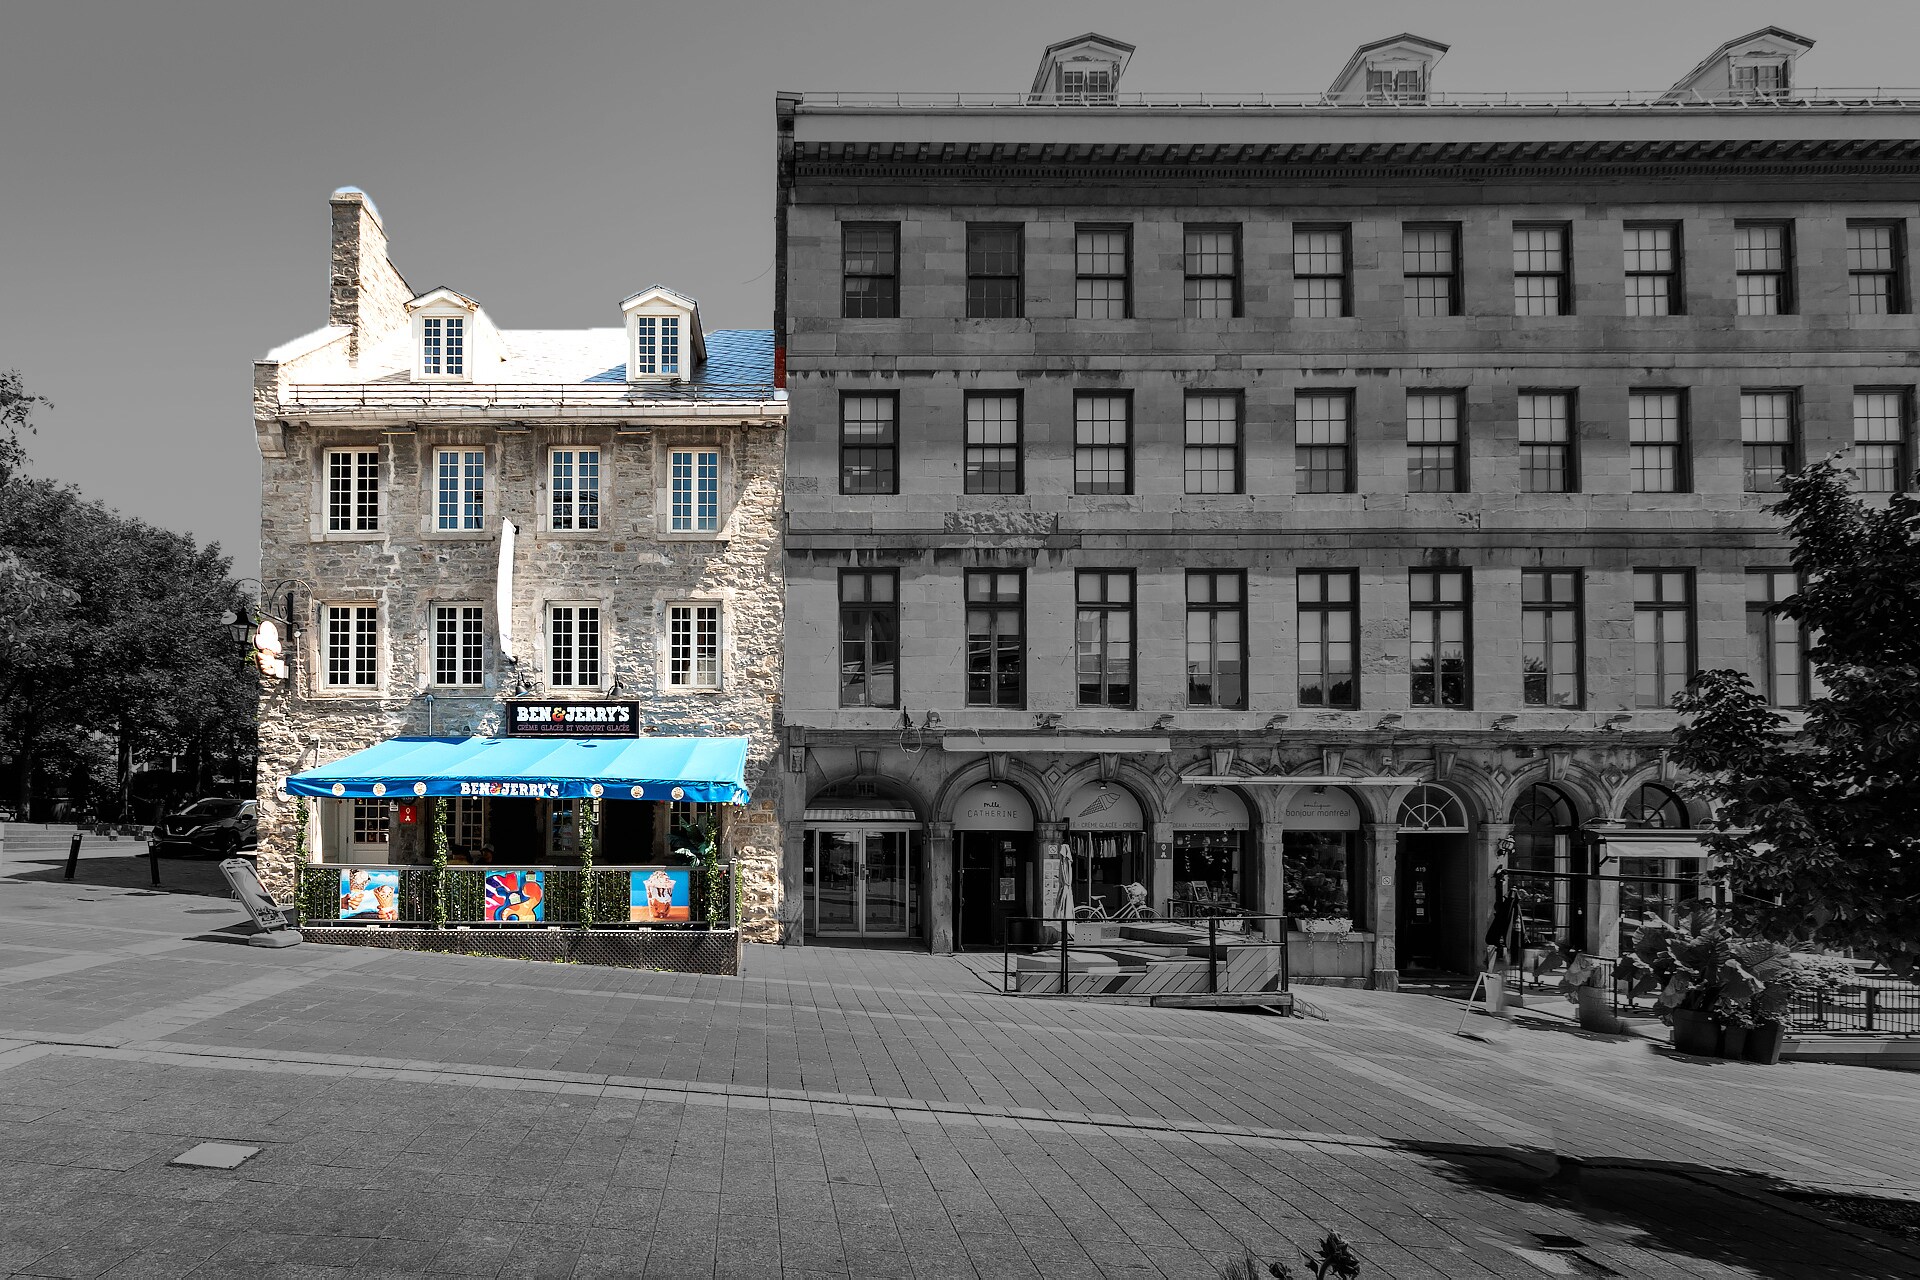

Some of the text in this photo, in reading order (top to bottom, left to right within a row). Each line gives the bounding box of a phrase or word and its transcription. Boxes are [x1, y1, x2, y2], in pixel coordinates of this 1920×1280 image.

[517, 723, 538, 731] CRÈME
[541, 723, 563, 731] GLACÉE
[607, 723, 630, 731] GLACÉE
[967, 809, 1017, 818] CATHERINE
[1285, 809, 1351, 818] bonjour montréal
